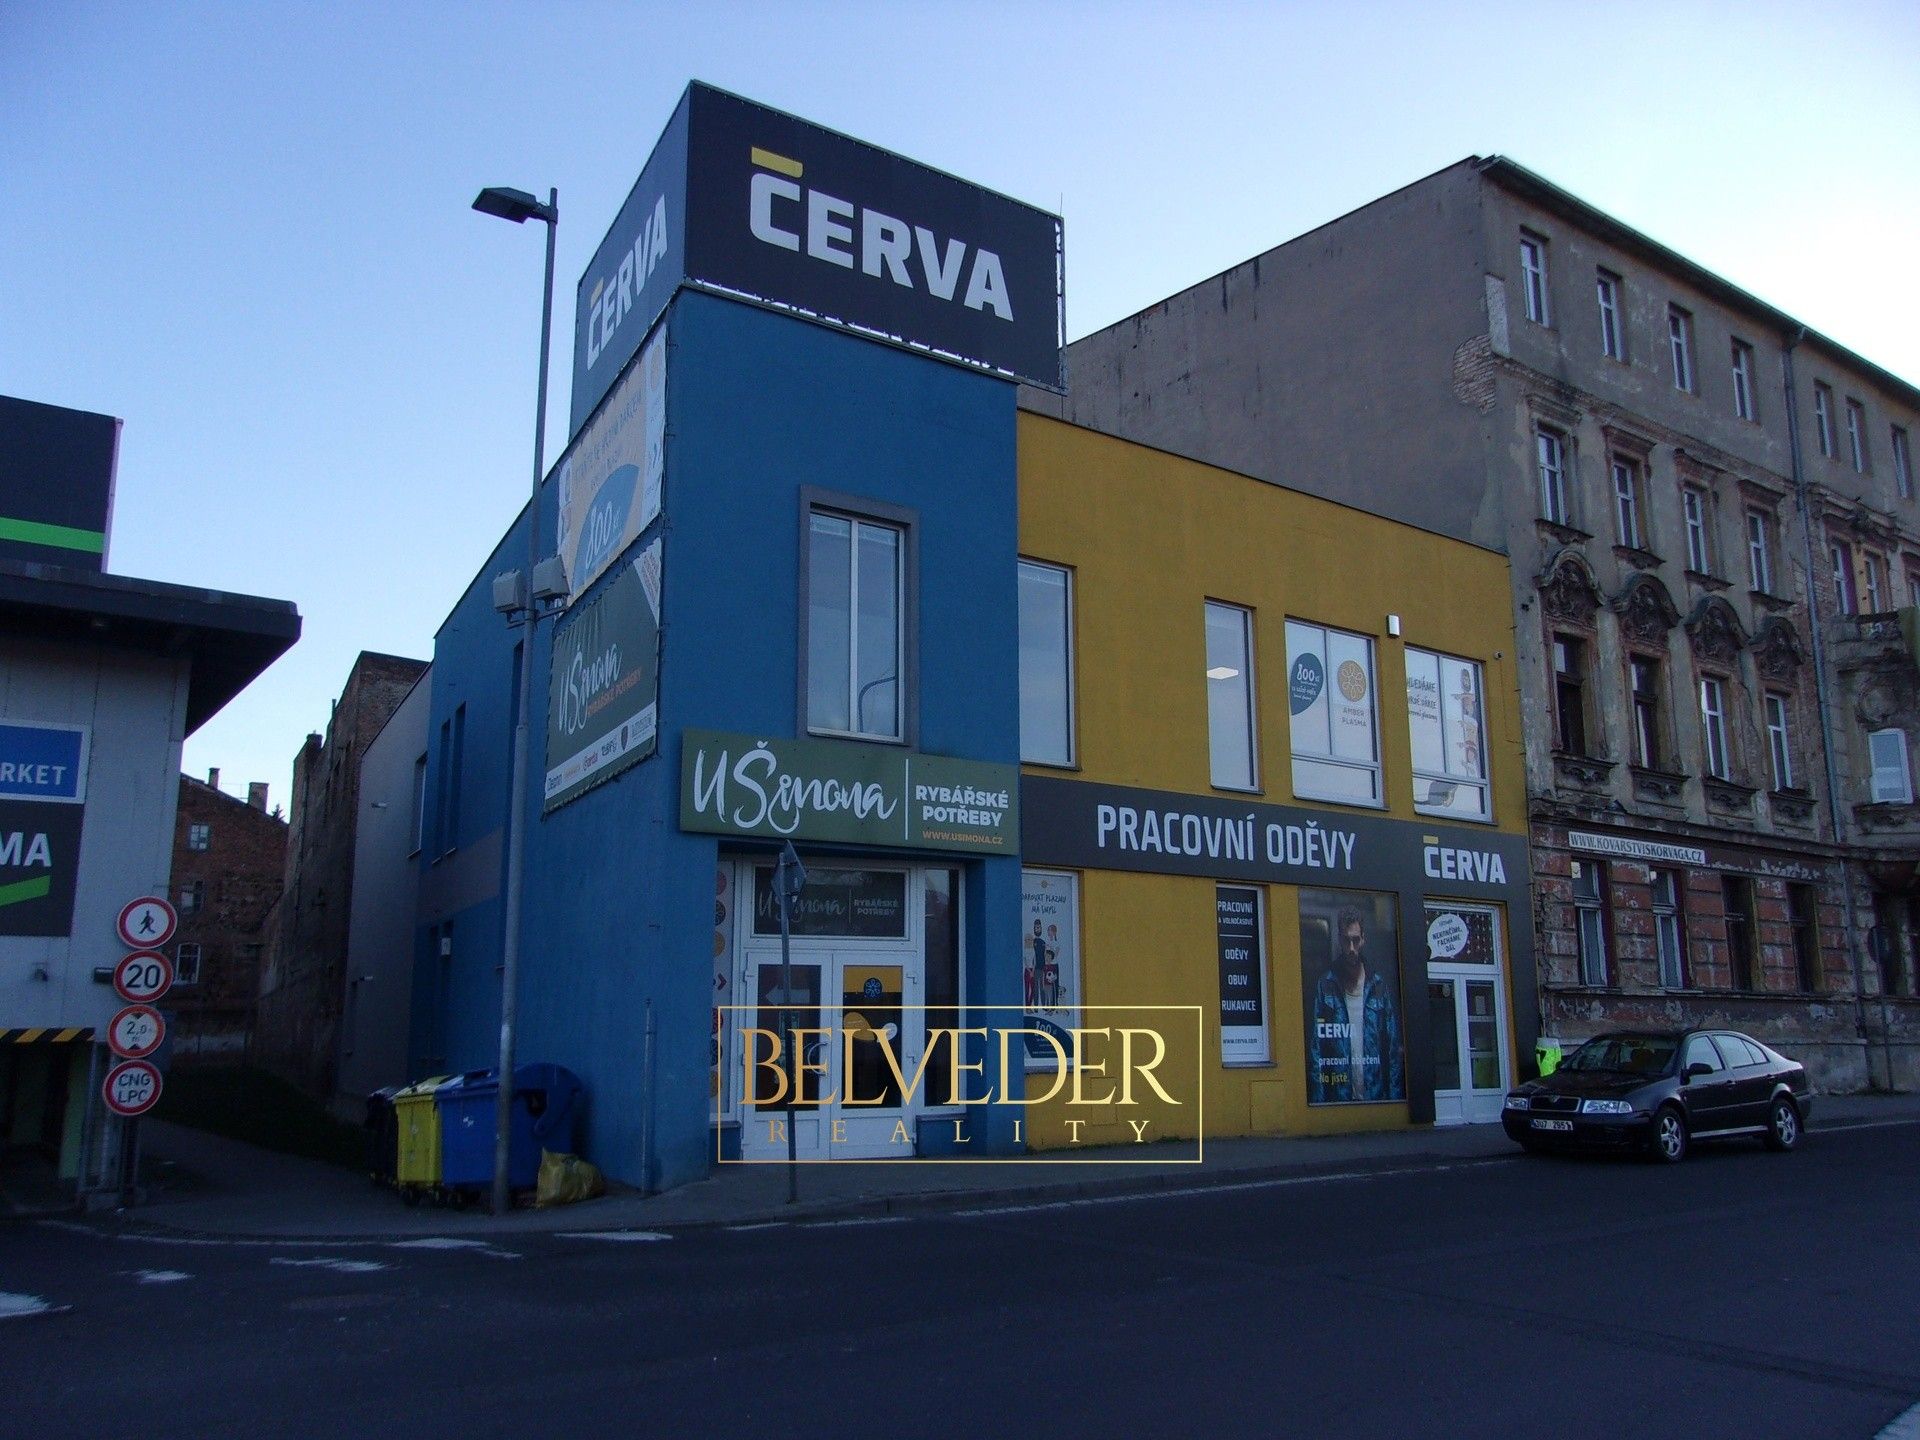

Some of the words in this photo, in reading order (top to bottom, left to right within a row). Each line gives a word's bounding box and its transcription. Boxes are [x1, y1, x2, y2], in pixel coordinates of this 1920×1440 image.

[1297, 663, 1315, 682] 800
[0, 761, 67, 785] RKET
[915, 784, 1009, 809] RYBÁŘSKÉ
[923, 805, 1003, 827] POTŘEBY
[922, 830, 1004, 845] WWW.USIMONA.CZ
[1097, 803, 1256, 862] PRACOVNÍ
[1266, 820, 1357, 871] ODĚVY
[1217, 900, 1253, 913] PRACOVNÍ
[1225, 947, 1249, 960] ODĚVY
[126, 964, 160, 989] 20
[1228, 974, 1248, 985] OBUV
[1221, 1000, 1256, 1011] RUKAVICE
[118, 1073, 151, 1086] CNG
